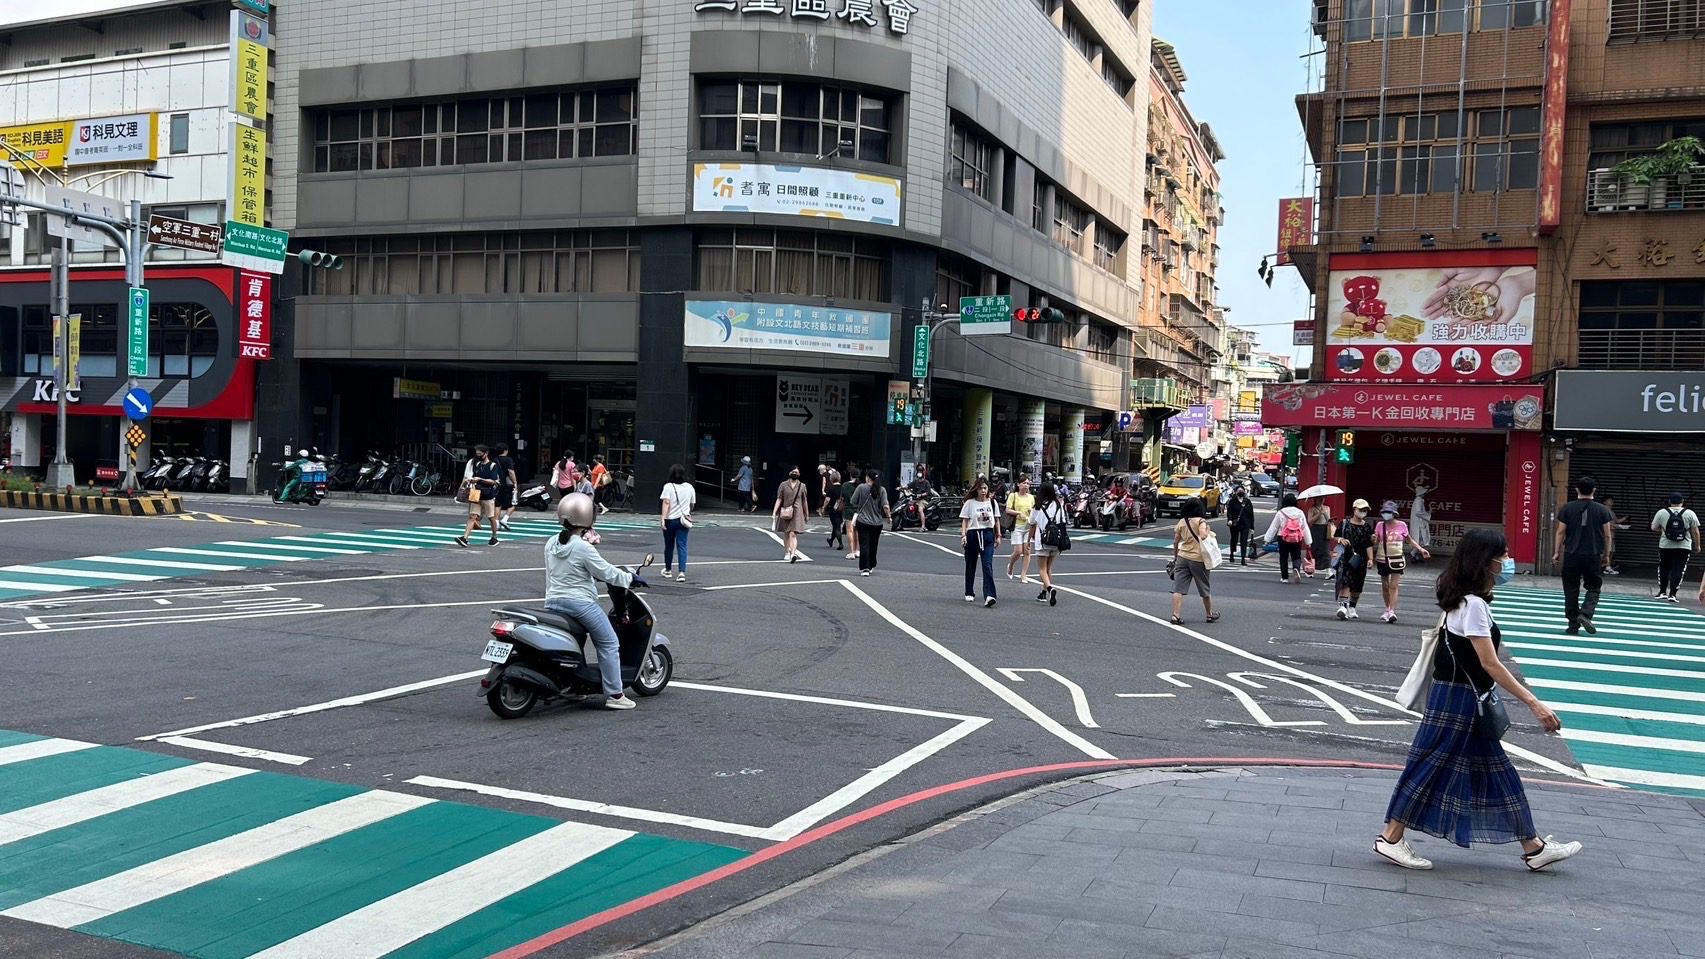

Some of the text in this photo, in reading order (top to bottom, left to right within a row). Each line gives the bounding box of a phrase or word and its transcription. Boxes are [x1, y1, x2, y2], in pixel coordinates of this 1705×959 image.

[243, 43, 261, 115] 三重區農會
[22, 128, 64, 147] 科見美語
[92, 122, 138, 140] 科見文理
[776, 184, 819, 198] 日間照顧
[162, 220, 219, 241] 空軍三重一村
[247, 278, 264, 339] 肯德基
[1431, 322, 1527, 341] 強力收購中
[242, 346, 267, 358] KFC
[916, 332, 926, 366] 文化北路
[1641, 384, 1705, 413] feli
[1341, 432, 1354, 446] 19
[1396, 436, 1466, 445] JEWEL CAFE
[1522, 474, 1532, 533] JEWEL CAFE
